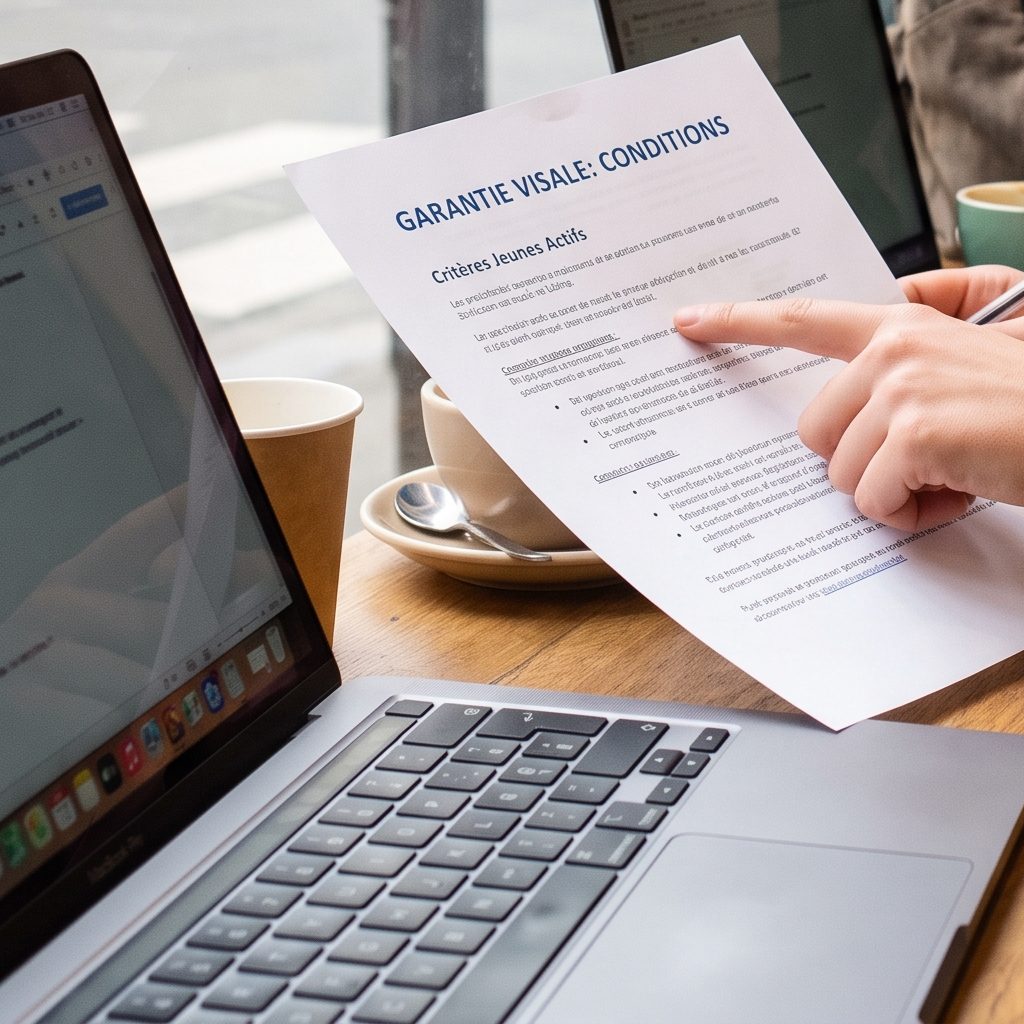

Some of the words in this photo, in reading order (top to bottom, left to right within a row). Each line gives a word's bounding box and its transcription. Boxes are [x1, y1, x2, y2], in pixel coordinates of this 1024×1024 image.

[395, 183, 514, 232] GARANTIE
[511, 160, 598, 197] VISALE:
[598, 115, 730, 172] CONDITIONS
[431, 259, 492, 285] Critères
[492, 243, 544, 267] Jeunes
[545, 227, 588, 252] Actifs
